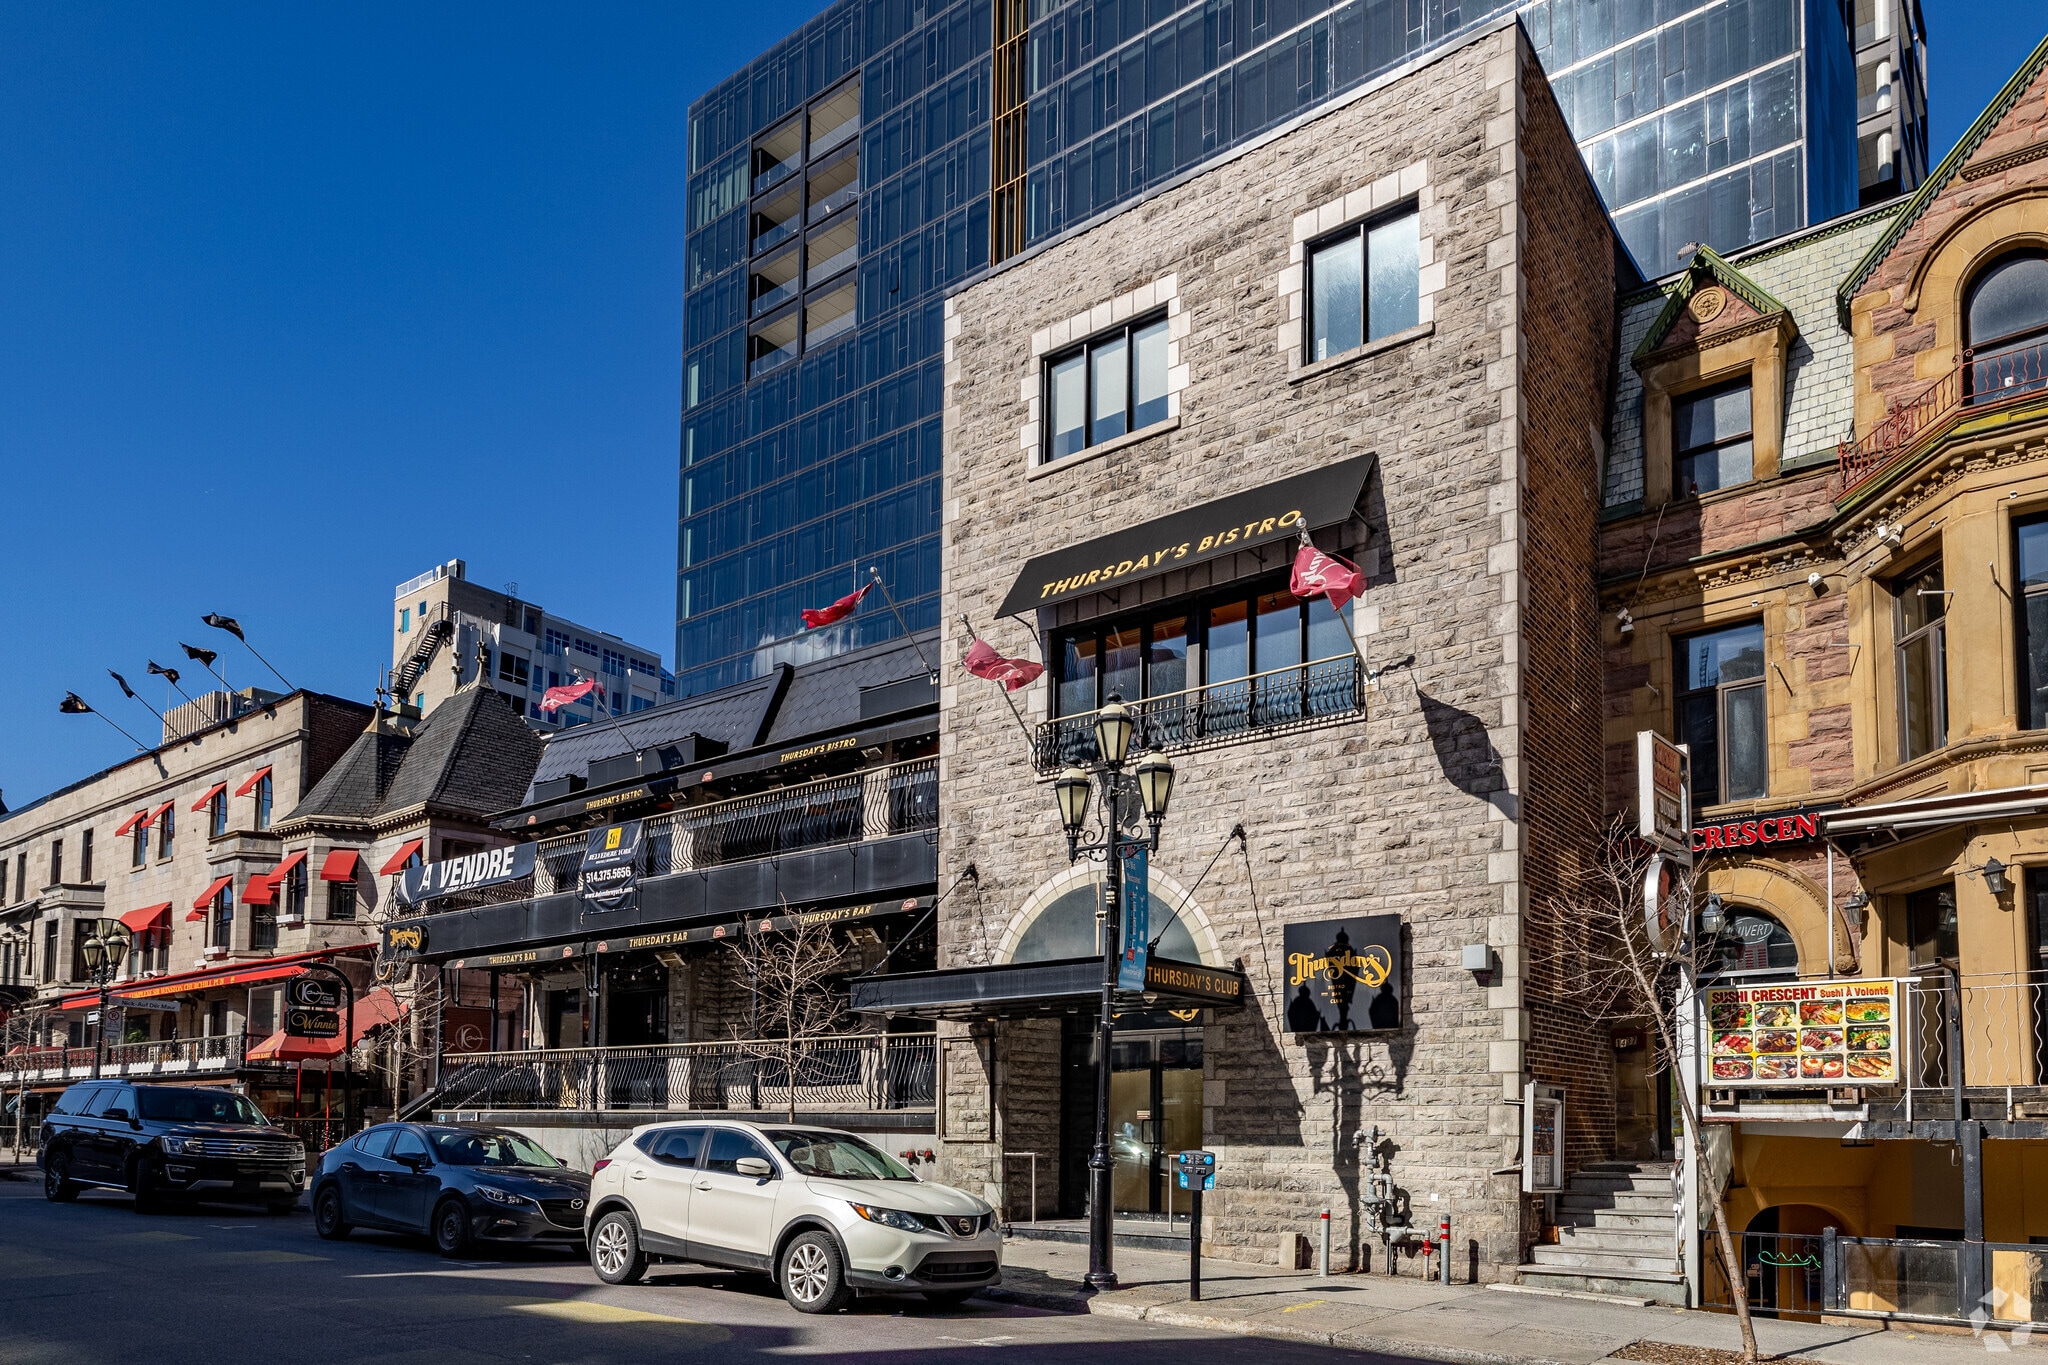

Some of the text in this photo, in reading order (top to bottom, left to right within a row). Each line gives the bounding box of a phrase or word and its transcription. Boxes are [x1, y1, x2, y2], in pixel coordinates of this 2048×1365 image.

[1040, 510, 1302, 599] THURSDAY'S BISTRO
[780, 737, 857, 762] THURSDAY'S BISTRO
[585, 788, 643, 811] THURSDAY'S BISTRO
[1658, 798, 1678, 821] SUSHI
[1691, 812, 1820, 852] CRESCEN
[439, 845, 516, 889] VENDRE
[585, 865, 632, 884] 514.375.5656
[799, 905, 871, 925] THURSDAY'S BAR
[629, 931, 688, 948] THURSDAY'S BAR
[488, 952, 537, 966] THURSDAY'S BAR
[1288, 944, 1392, 988] Thursday's
[1147, 966, 1240, 996] THURSDAY'S CLUB
[1712, 990, 1748, 1003] SUSHI
[1751, 987, 1817, 1003] CRESCENT
[1820, 988, 1844, 999] Sushi
[1846, 986, 1853, 997] À
[1855, 986, 1889, 997] Volonté
[291, 1012, 338, 1030] Winnie
